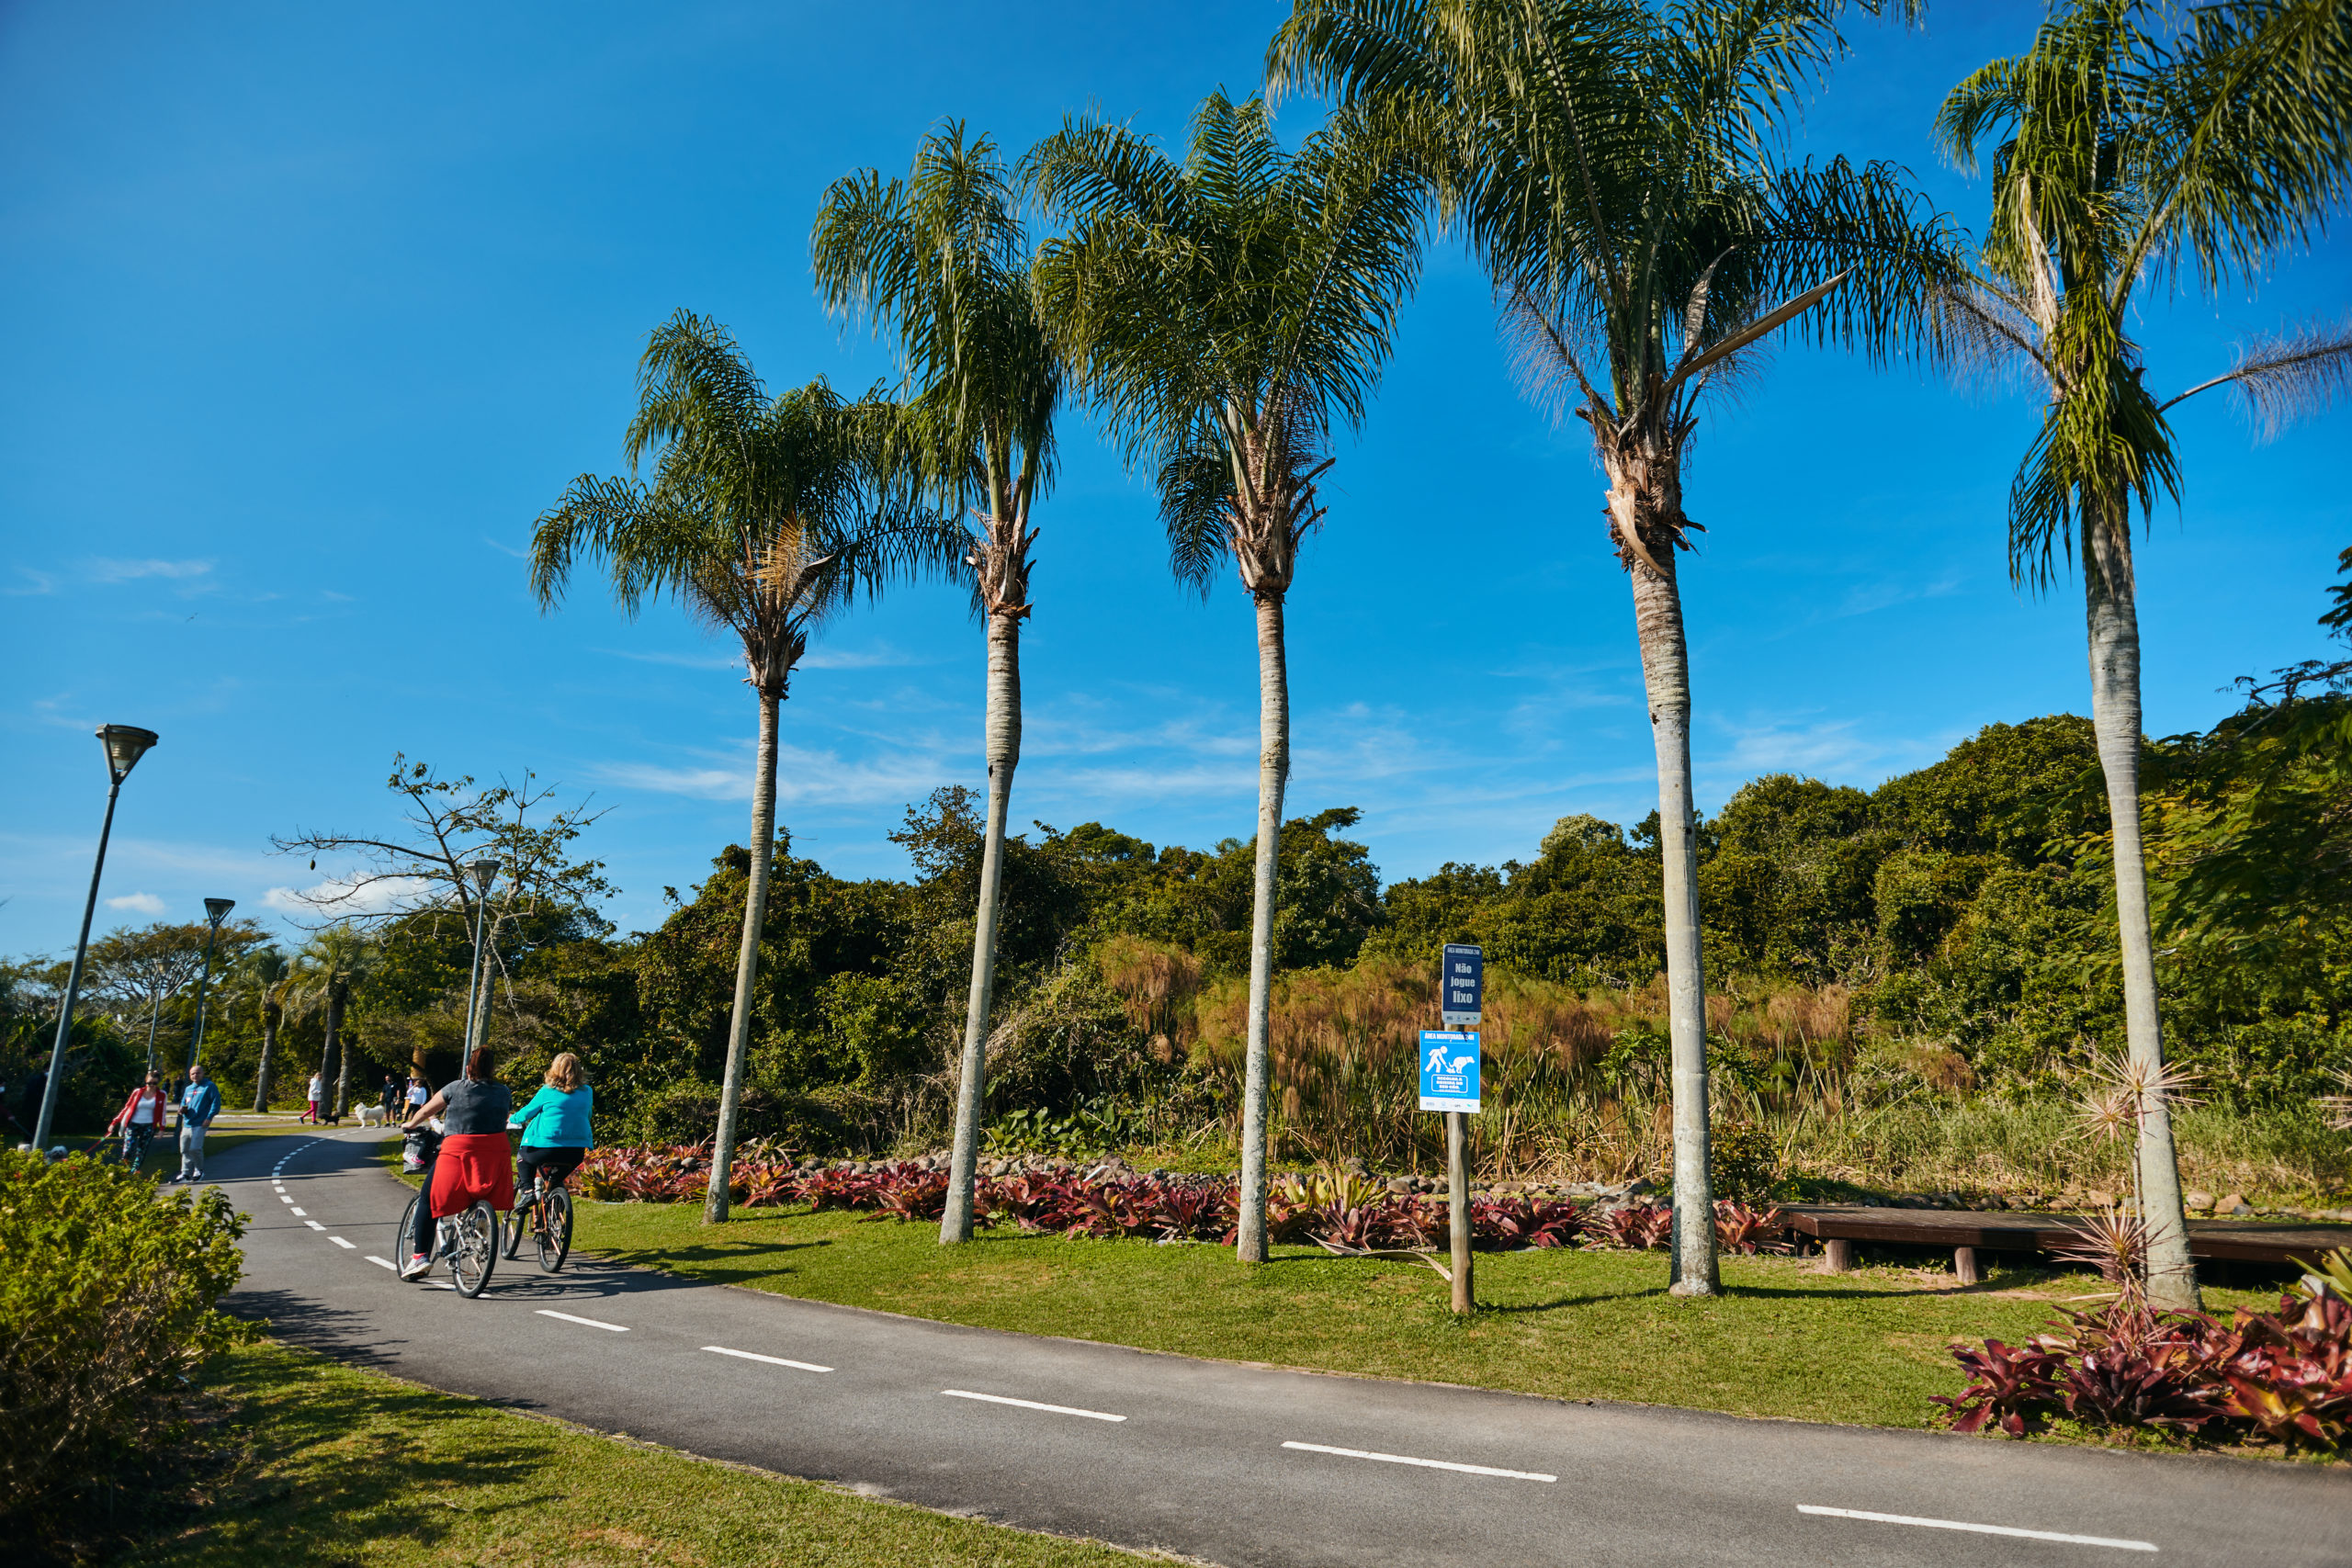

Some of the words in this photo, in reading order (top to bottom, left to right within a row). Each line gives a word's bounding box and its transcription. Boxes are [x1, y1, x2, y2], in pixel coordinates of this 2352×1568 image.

[1455, 963, 1472, 974] Não
[1450, 976, 1475, 987] jogue
[1453, 991, 1473, 1004] lixo
